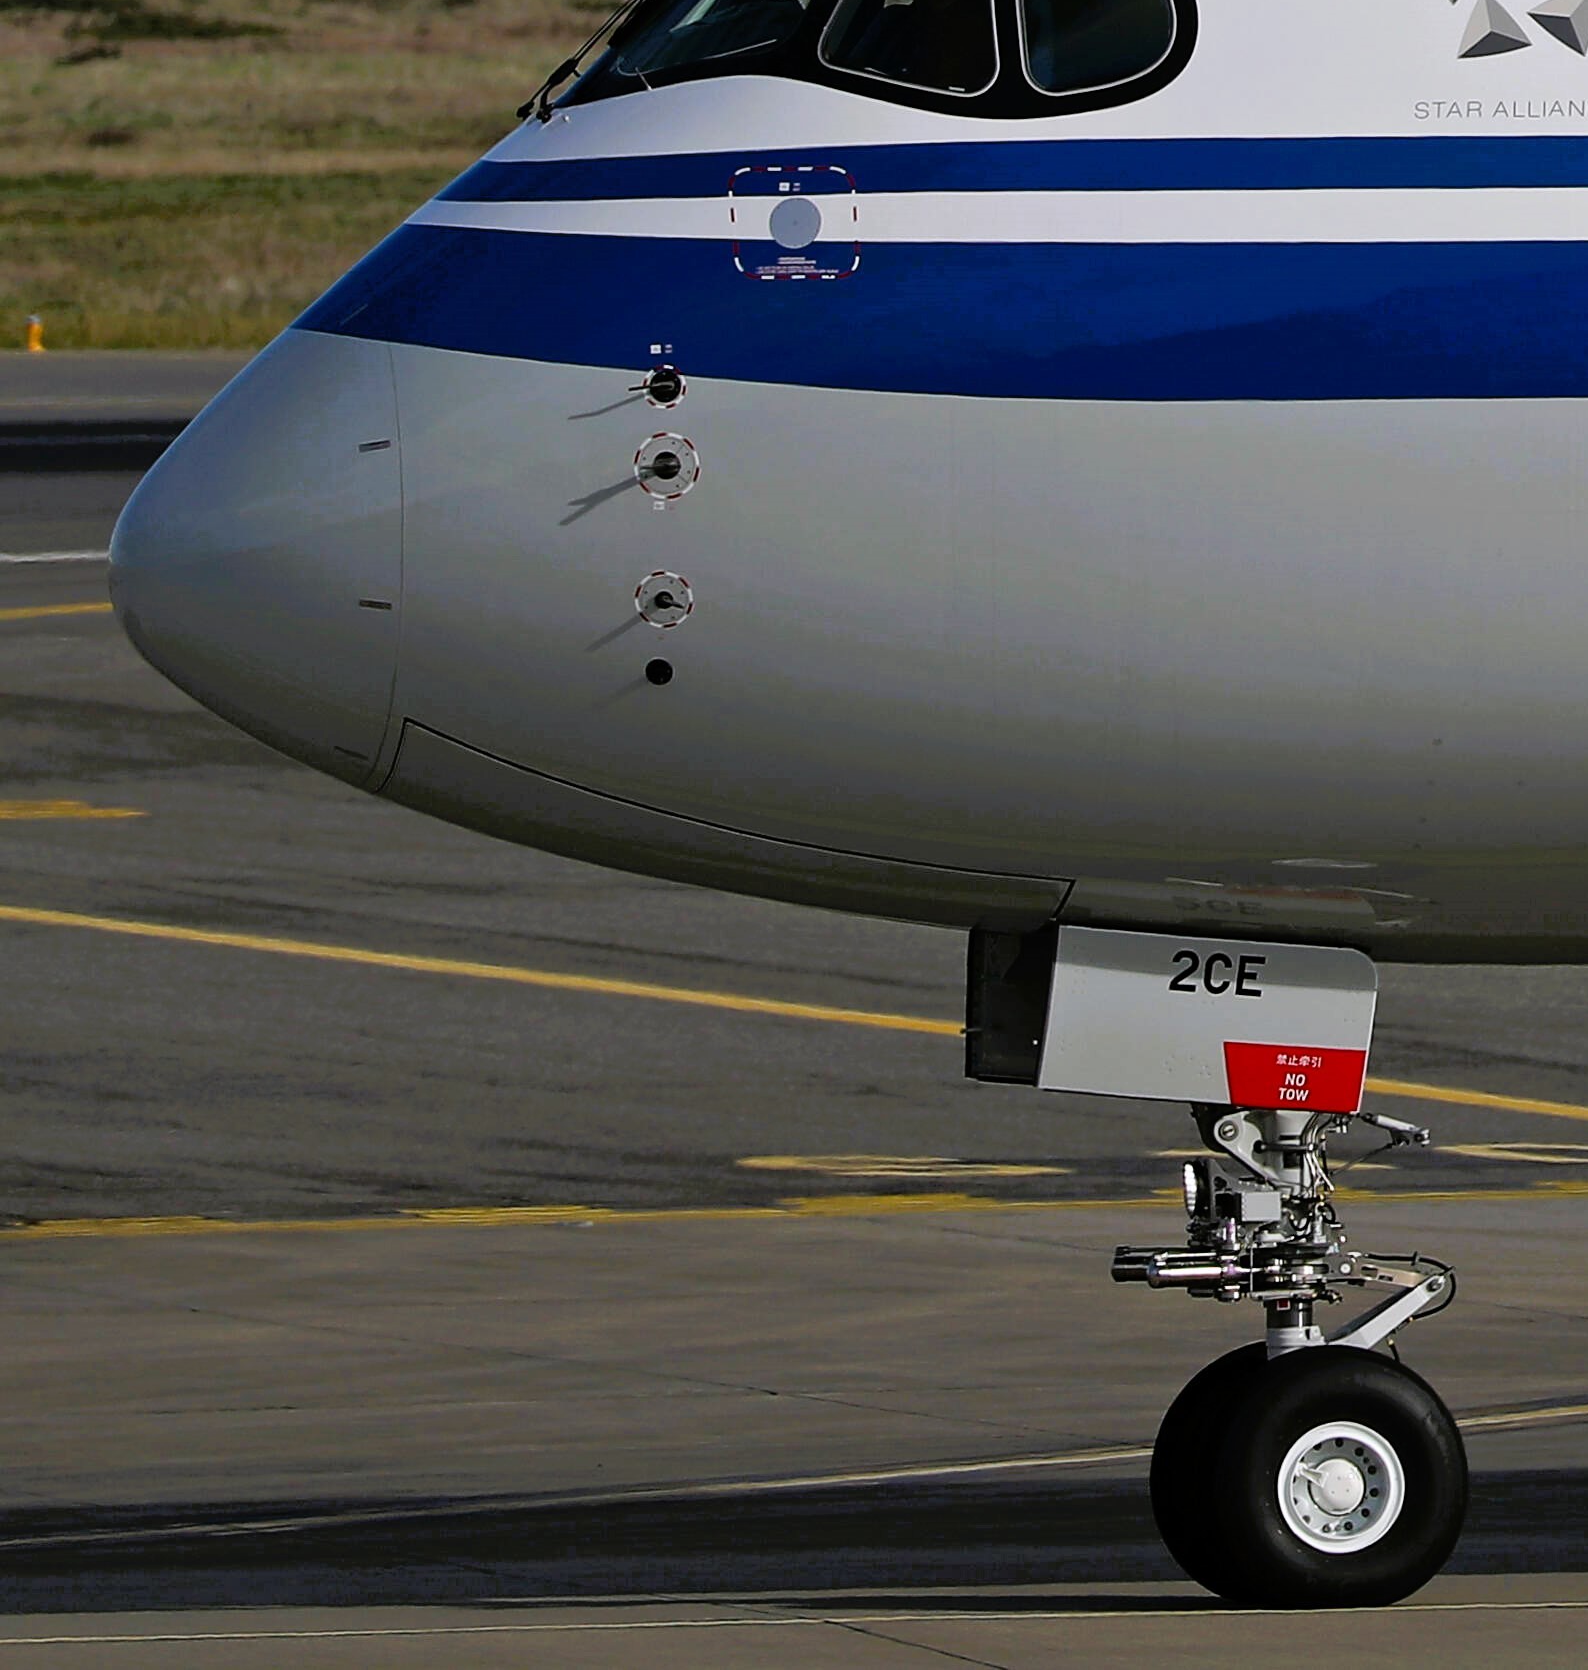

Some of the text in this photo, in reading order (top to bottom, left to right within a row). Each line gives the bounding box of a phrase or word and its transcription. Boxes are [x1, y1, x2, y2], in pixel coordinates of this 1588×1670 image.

[1413, 100, 1483, 120] STAR
[1168, 950, 1267, 998] 2CE
[1276, 1053, 1322, 1068] 禁止牵引
[1284, 1073, 1306, 1087] NO
[1278, 1087, 1309, 1101] TOW
